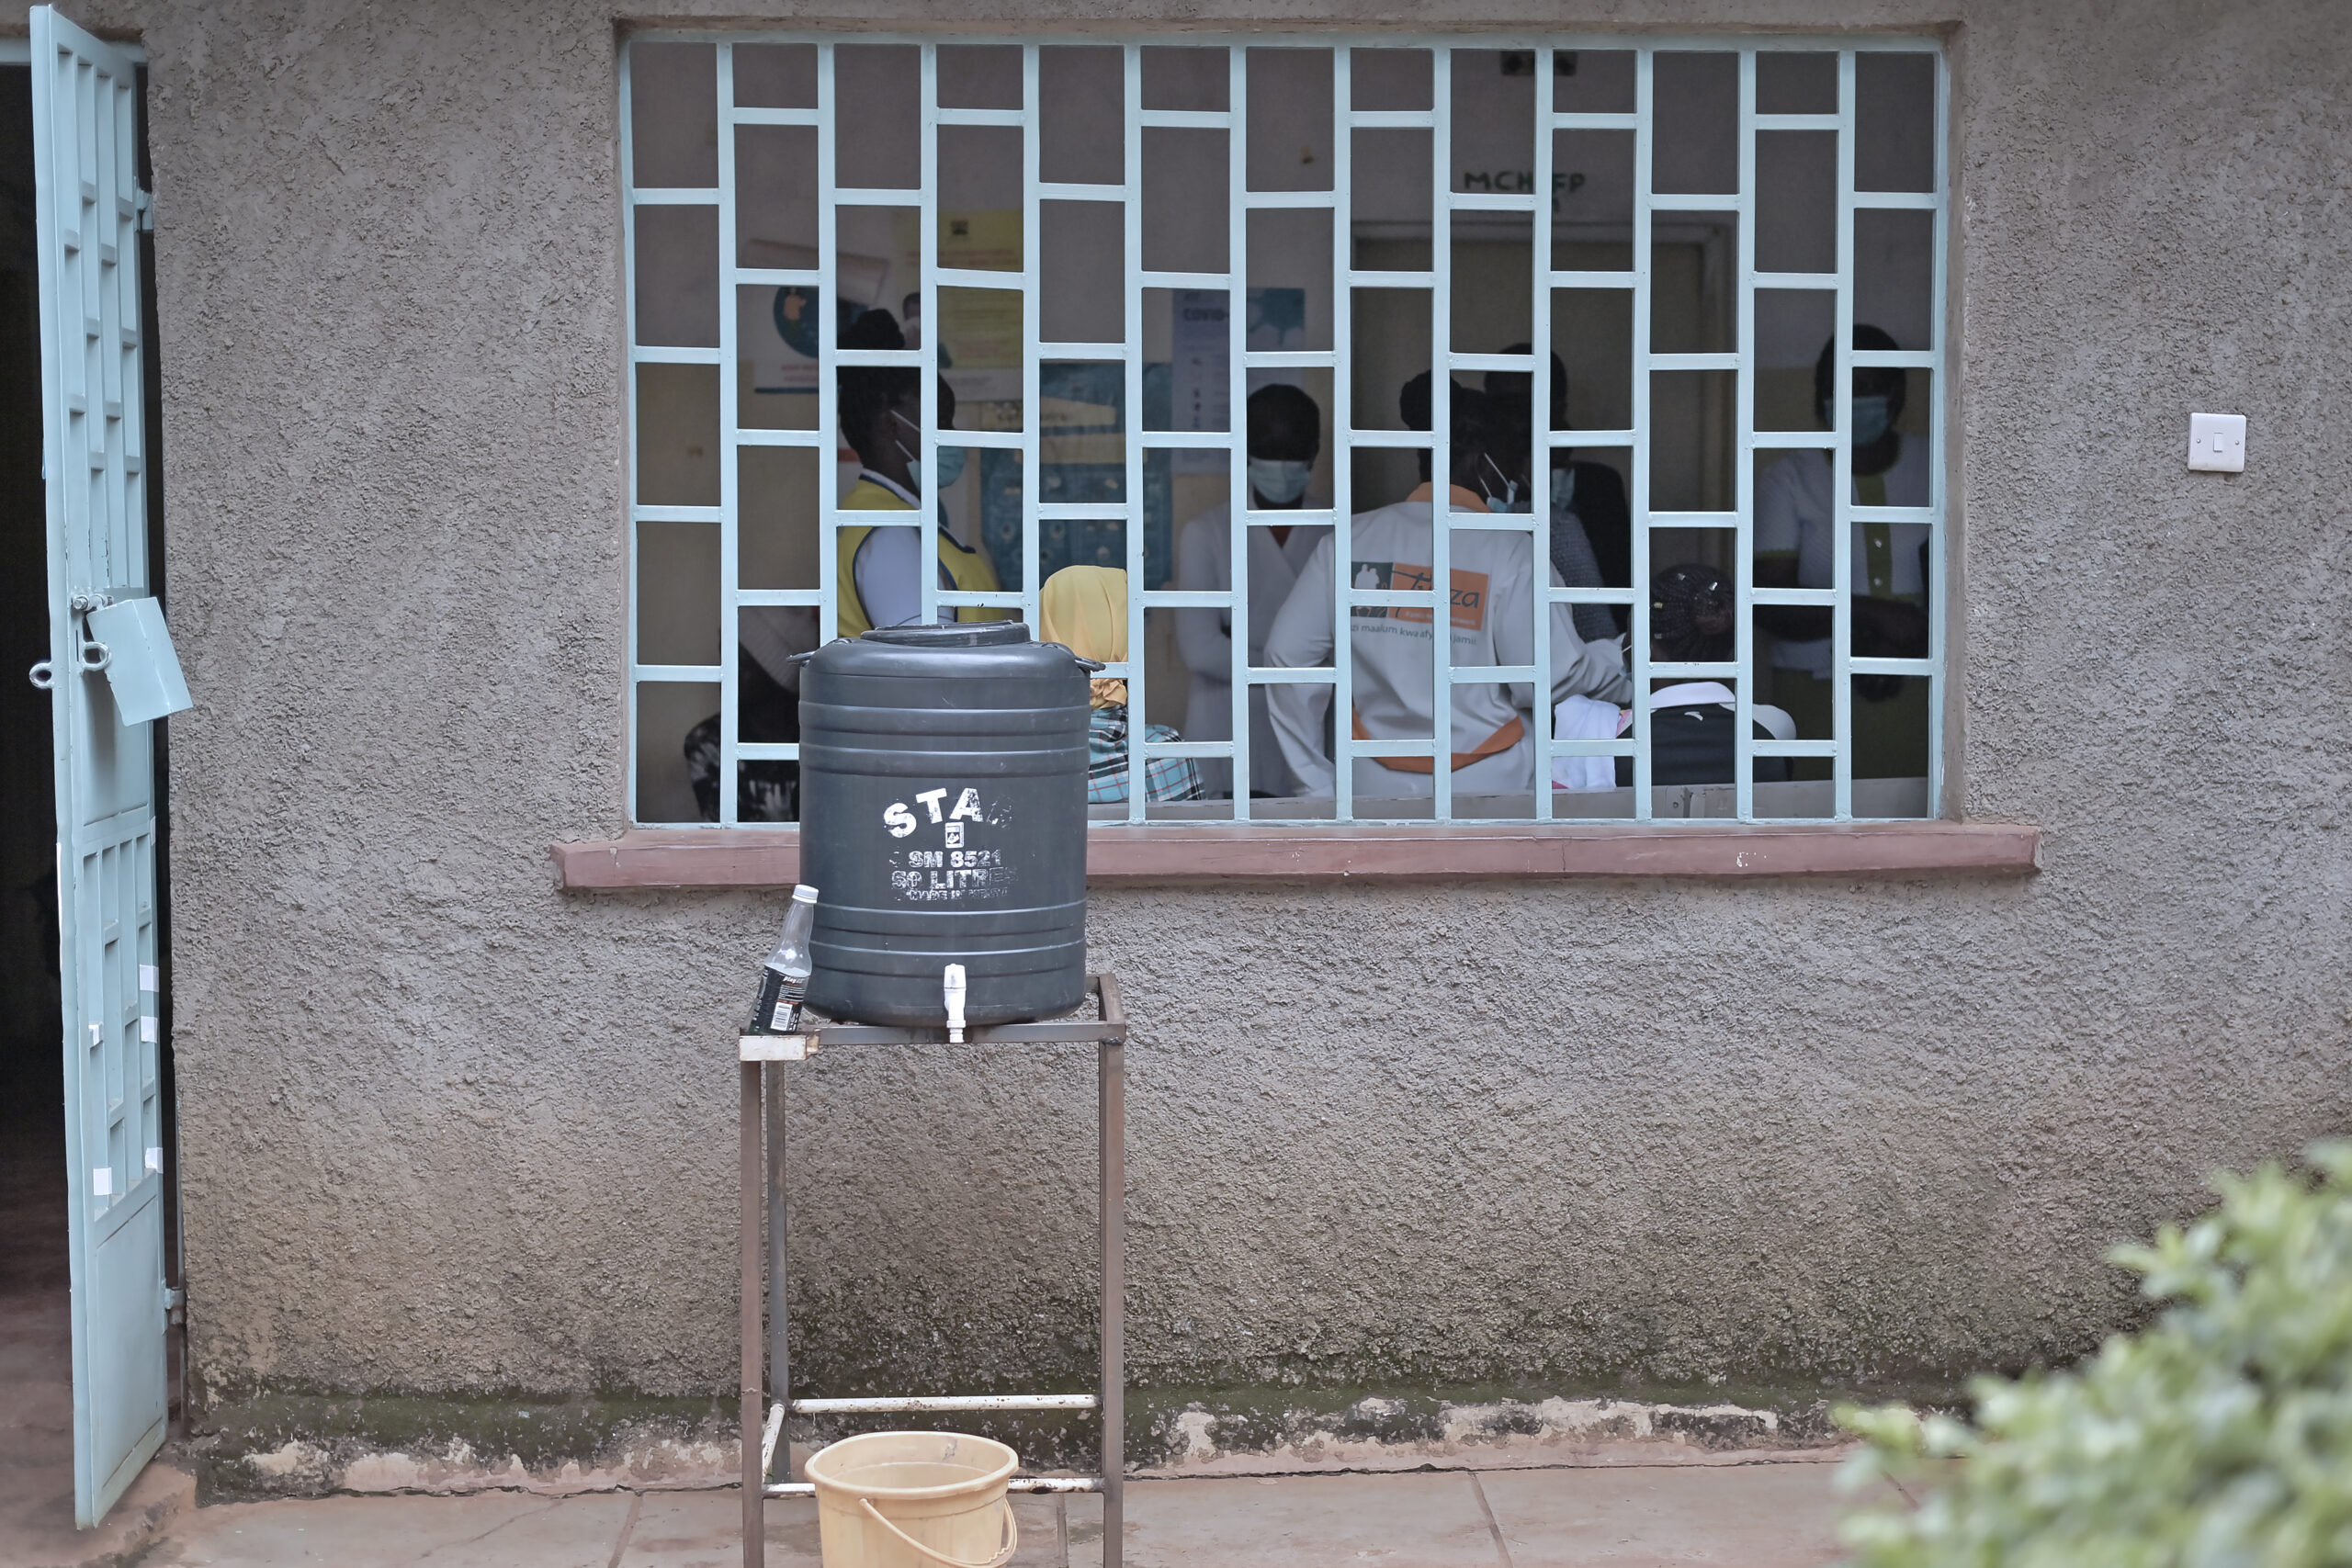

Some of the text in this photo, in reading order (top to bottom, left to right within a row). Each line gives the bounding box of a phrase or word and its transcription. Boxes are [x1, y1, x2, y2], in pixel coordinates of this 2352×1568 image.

[1182, 308, 1229, 321] COVID-
[1391, 570, 1481, 618] Tza
[884, 787, 1012, 839] STA
